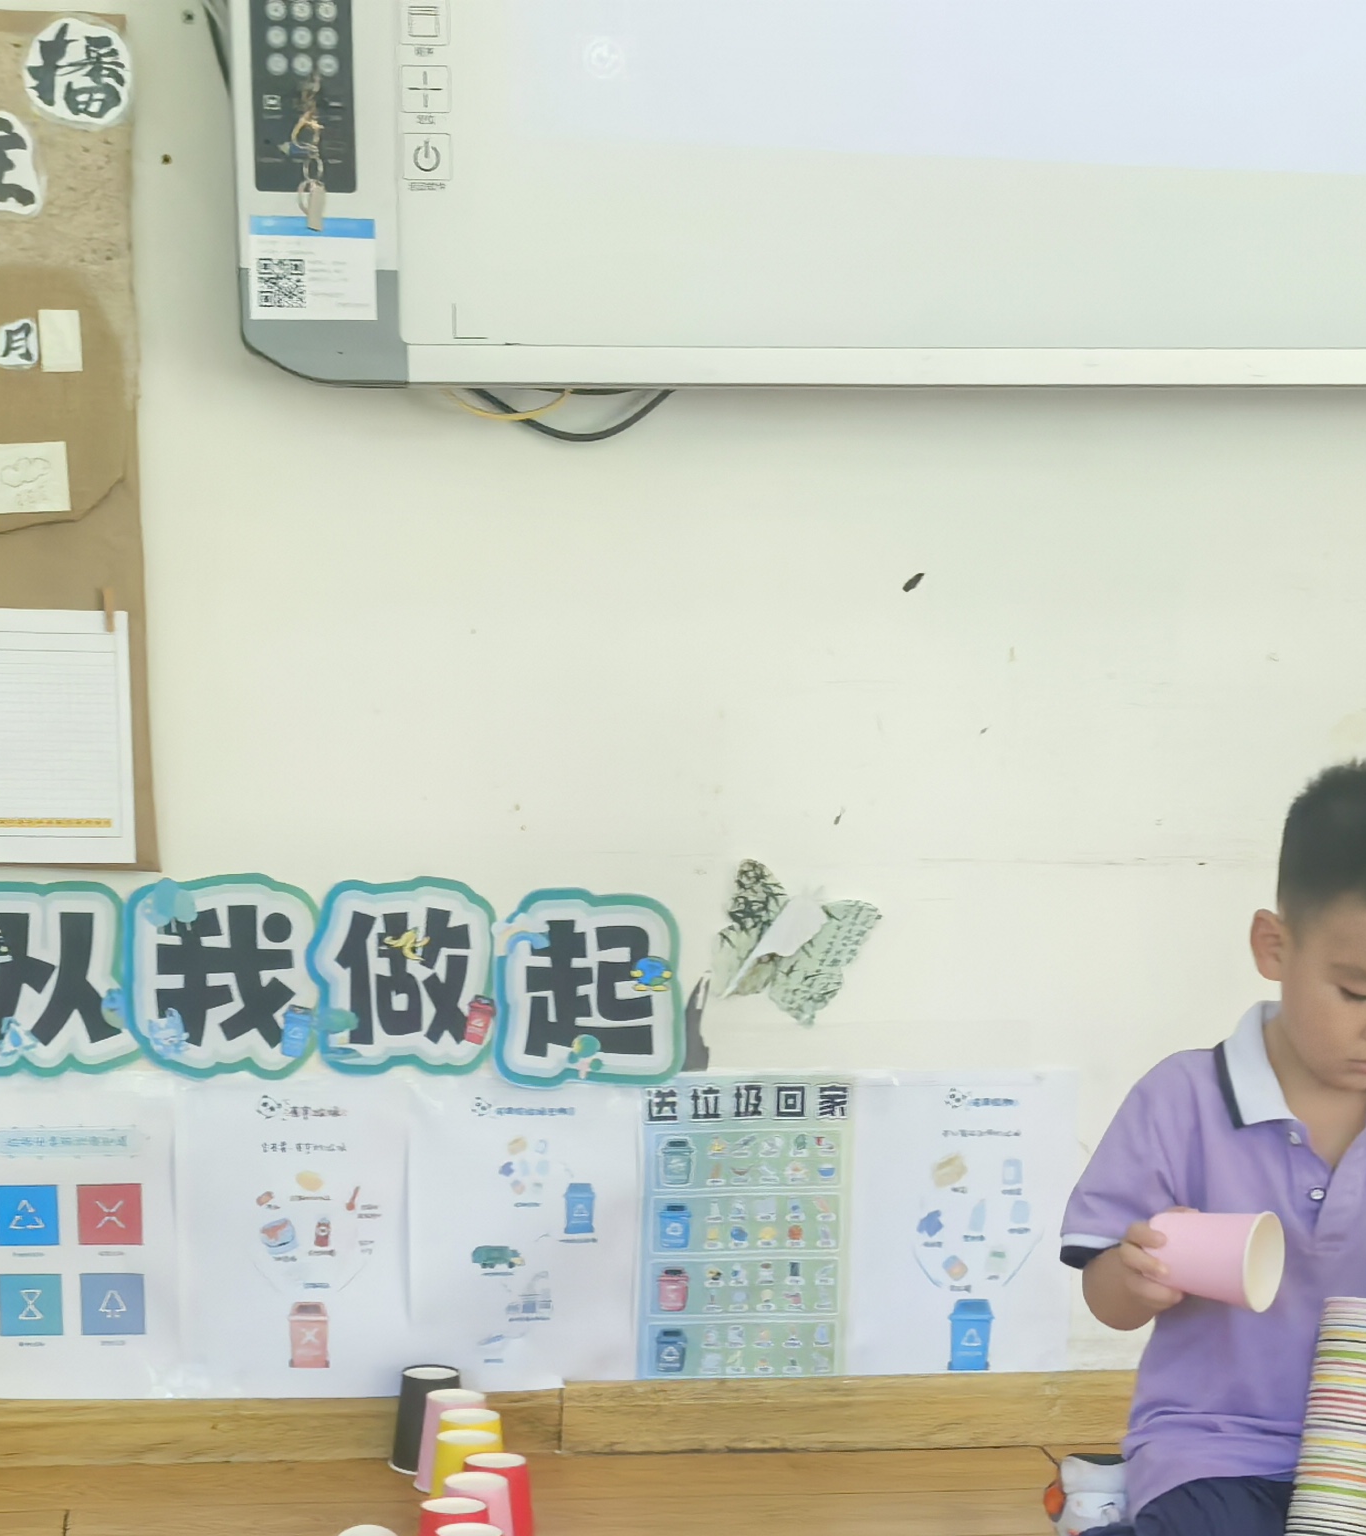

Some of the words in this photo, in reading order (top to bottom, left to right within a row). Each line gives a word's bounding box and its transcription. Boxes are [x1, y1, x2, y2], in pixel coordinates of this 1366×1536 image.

[1, 321, 34, 362] 月
[647, 1084, 849, 1122] 送垃圾回家
